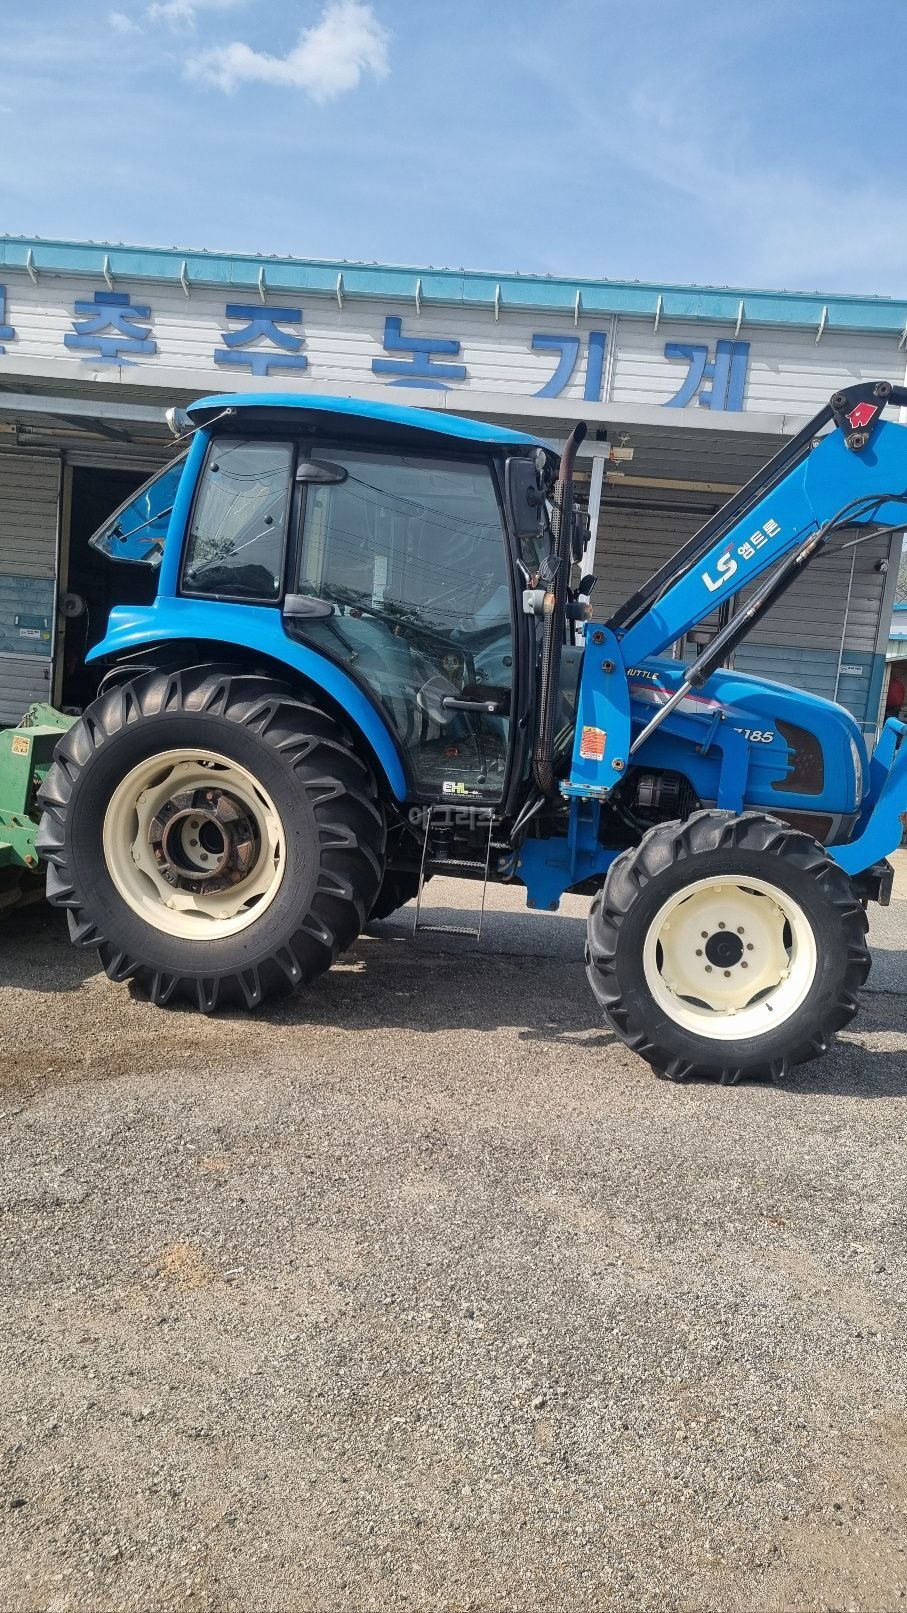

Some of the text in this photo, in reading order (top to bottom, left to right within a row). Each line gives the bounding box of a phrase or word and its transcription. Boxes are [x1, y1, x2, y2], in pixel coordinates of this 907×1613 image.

[0, 284, 751, 412] 충주농기계
[702, 518, 781, 592] LS 엠트론
